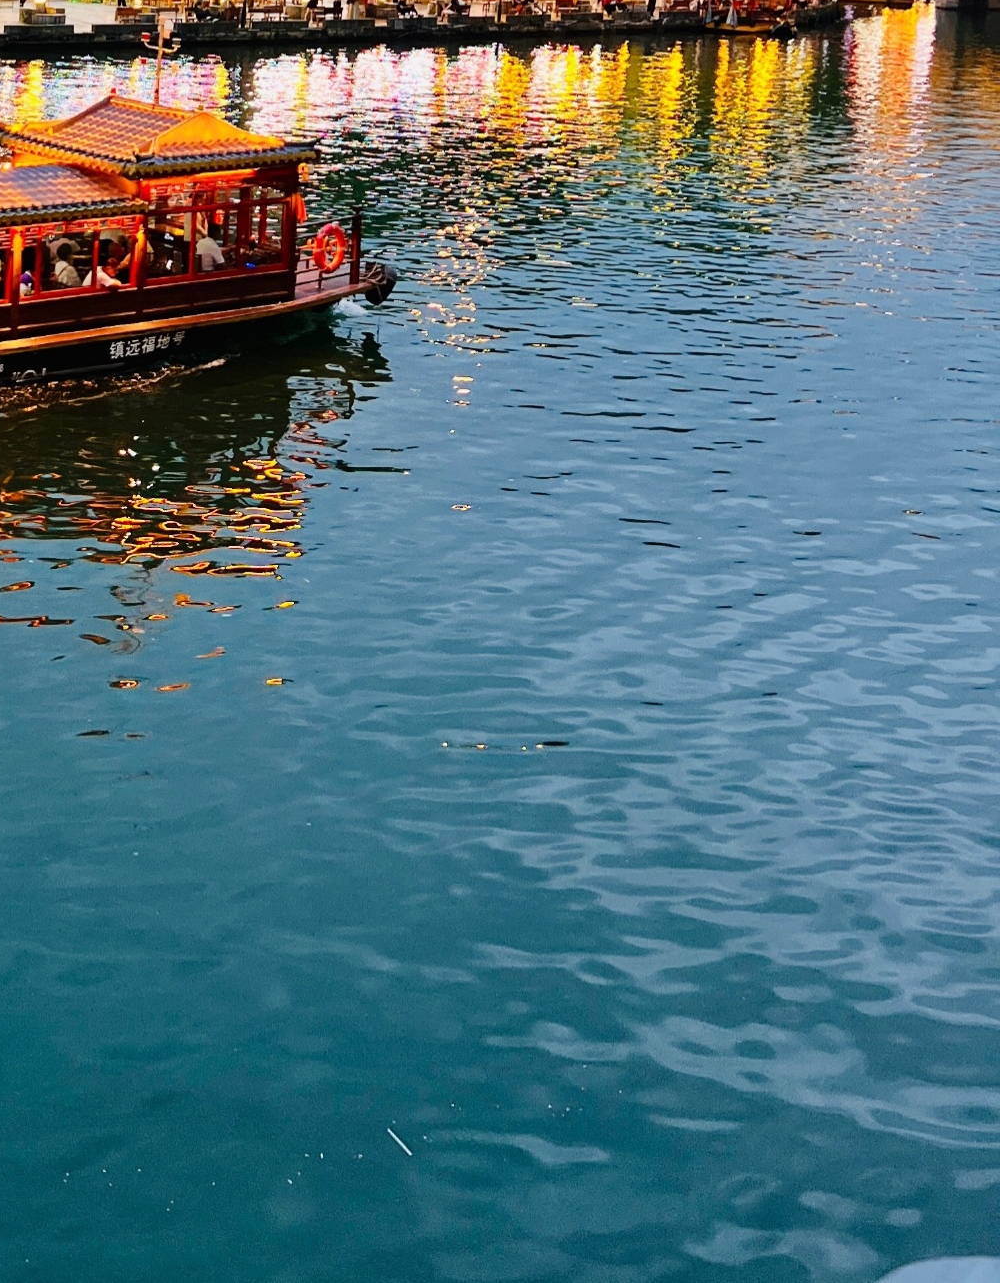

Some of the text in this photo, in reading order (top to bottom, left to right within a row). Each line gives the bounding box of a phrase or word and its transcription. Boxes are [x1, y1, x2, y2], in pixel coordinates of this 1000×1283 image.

[109, 331, 186, 359] 镇远福地号
